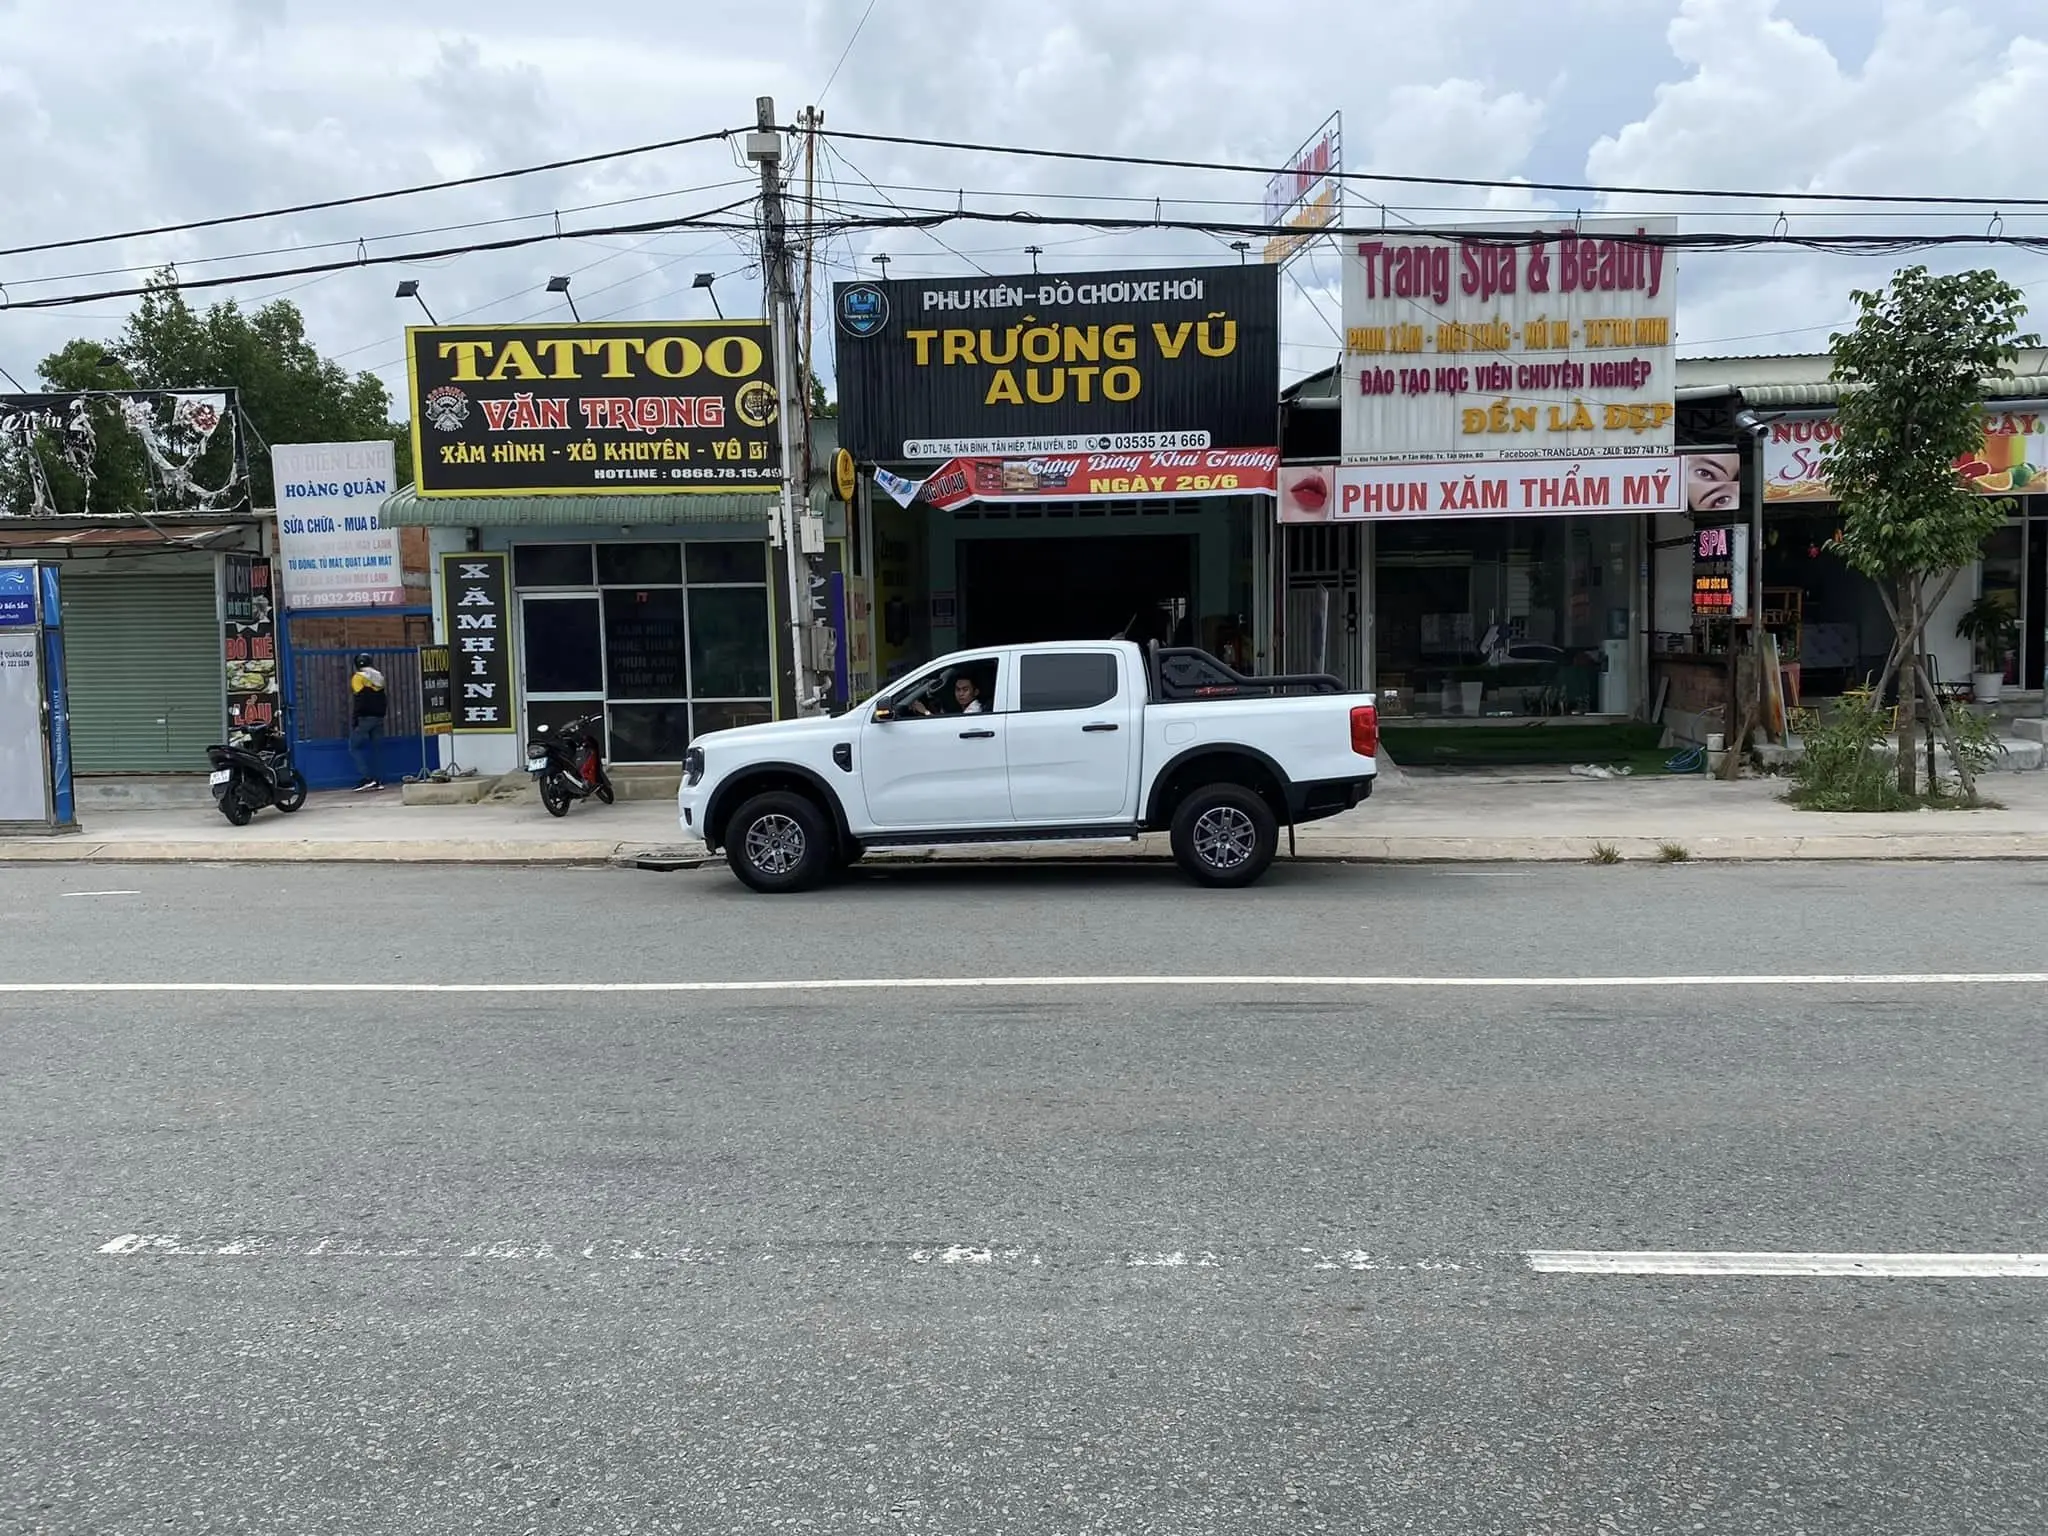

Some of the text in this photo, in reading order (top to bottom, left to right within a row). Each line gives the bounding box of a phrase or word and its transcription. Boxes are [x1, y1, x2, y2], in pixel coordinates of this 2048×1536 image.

[1358, 227, 1665, 305] Trang Spa & Beauty
[1132, 282, 1161, 301] XE
[1163, 278, 1204, 300] HƠI
[905, 311, 1237, 366] TRƯỜNG VŨ
[1347, 327, 1386, 355] PHUN
[1389, 320, 1423, 354] XĂM
[1472, 313, 1512, 352] KHẮC
[1583, 318, 1634, 348] TATTOO
[1635, 317, 1669, 347] MINI
[438, 336, 764, 382] TATTOO
[984, 365, 1142, 406] AUTO
[1360, 356, 1652, 398] ĐÀO TẠO HỌC VIÊN CHUYÊN NGHIỆP
[478, 392, 726, 435] VĂN TRỌNG
[1462, 397, 1674, 435] ĐẾN LÀ ĐẸP
[440, 441, 487, 464] XĂM
[491, 440, 545, 463] HÌNH
[566, 438, 597, 462] XỎ
[603, 438, 690, 461] KHUYÊN
[712, 438, 742, 460] VÔ
[1115, 434, 1206, 449] 03535 24 666
[1500, 449, 1541, 459] Facebook:
[1542, 447, 1595, 457] TRANGLADA
[594, 468, 658, 479] HOTLINE
[1150, 451, 1202, 469] Khai
[286, 477, 386, 497] HOÀNG QUÂN
[1090, 473, 1239, 493] NGÀY 26/6
[1341, 463, 1672, 514] PHUN XĂM THẨM MỸ
[283, 514, 304, 534] SỬA
[307, 515, 335, 533] CHỮA
[345, 516, 368, 531] MUA
[1699, 529, 1728, 556] SPA
[226, 633, 273, 660] BÒ NÉ
[421, 649, 449, 672] TATTOO
[233, 694, 273, 726] LẨU
